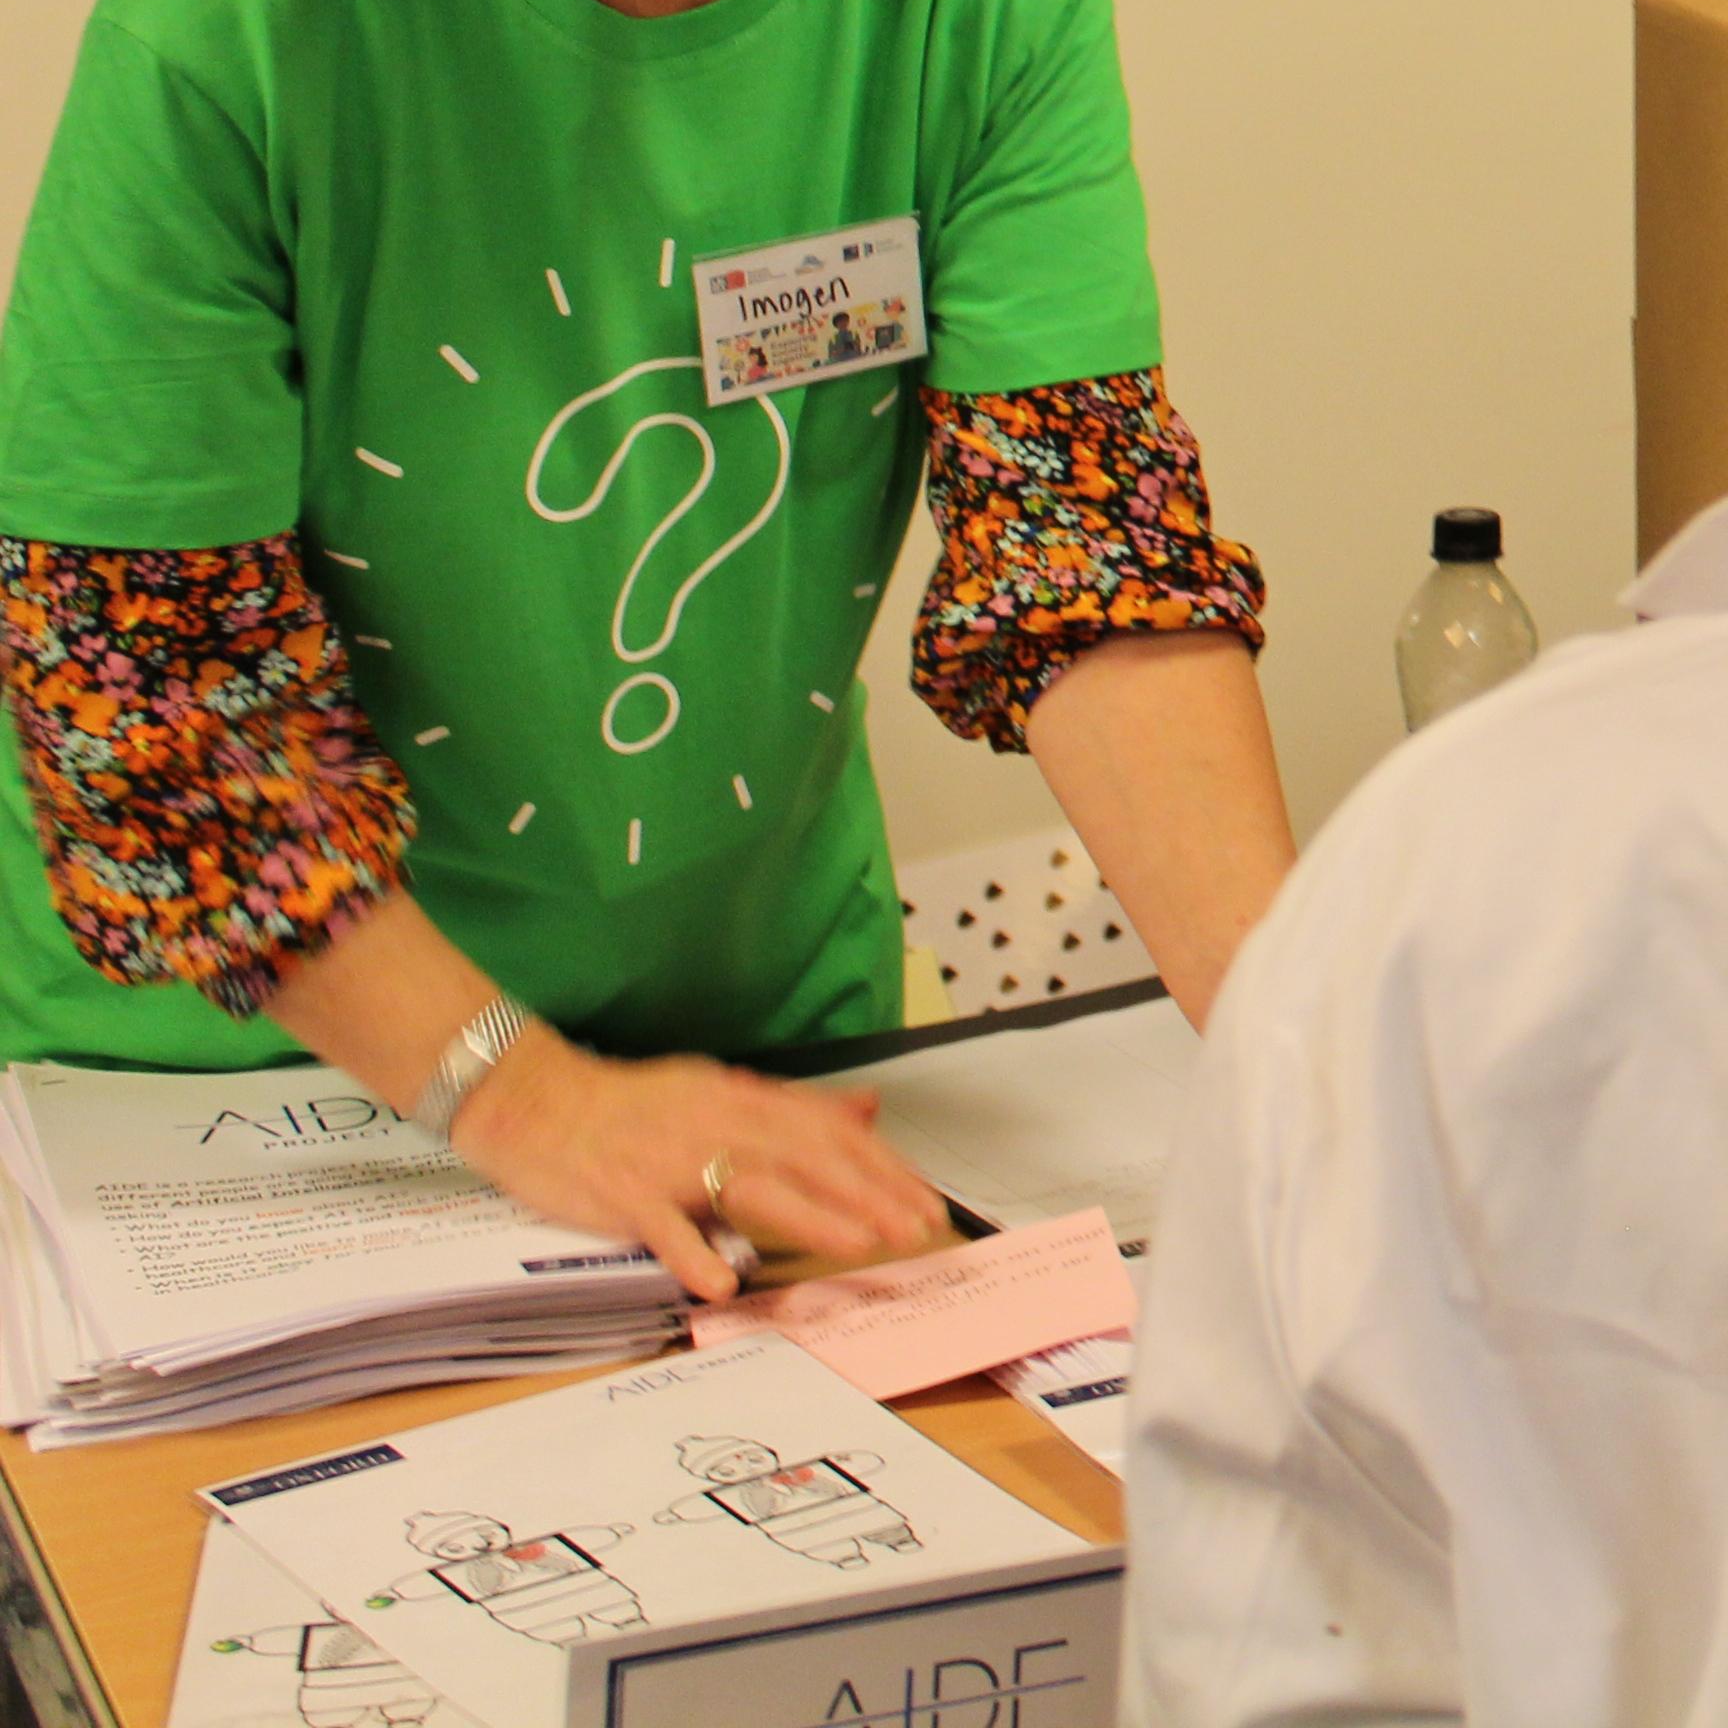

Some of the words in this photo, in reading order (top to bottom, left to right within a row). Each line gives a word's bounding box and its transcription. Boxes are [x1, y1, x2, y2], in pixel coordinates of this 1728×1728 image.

[738, 276, 850, 322] Imogen
[200, 1095, 411, 1144] AID
[264, 1128, 390, 1149] PROJECT
[126, 1220, 180, 1231] What
[187, 1217, 210, 1225] do
[217, 1214, 250, 1225] you
[256, 1207, 304, 1218] know
[311, 1199, 365, 1211] about
